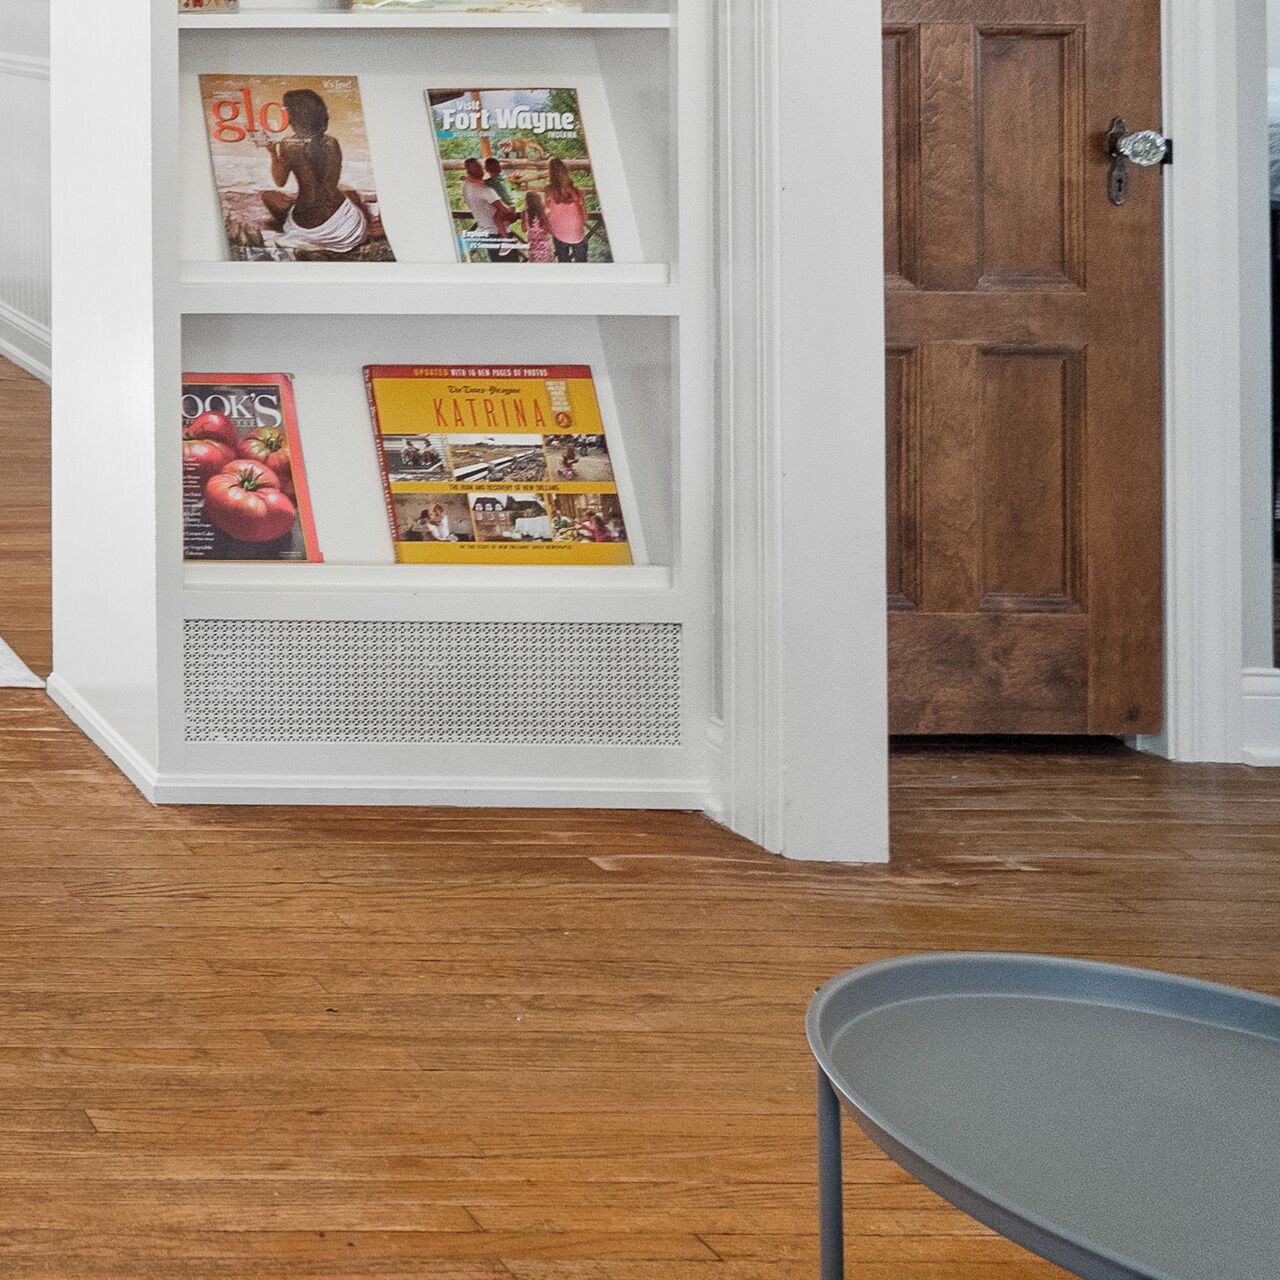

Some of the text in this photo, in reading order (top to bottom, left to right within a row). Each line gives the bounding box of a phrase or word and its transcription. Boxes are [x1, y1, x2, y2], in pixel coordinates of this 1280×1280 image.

[211, 87, 289, 142] glo
[442, 105, 575, 134] Fort Wayne
[456, 100, 481, 111] Visit
[450, 369, 466, 377] WITH
[478, 369, 490, 377] NEW
[492, 369, 512, 377] PAGES
[524, 369, 548, 377] PHOTOS
[432, 398, 546, 427] KATRINA
